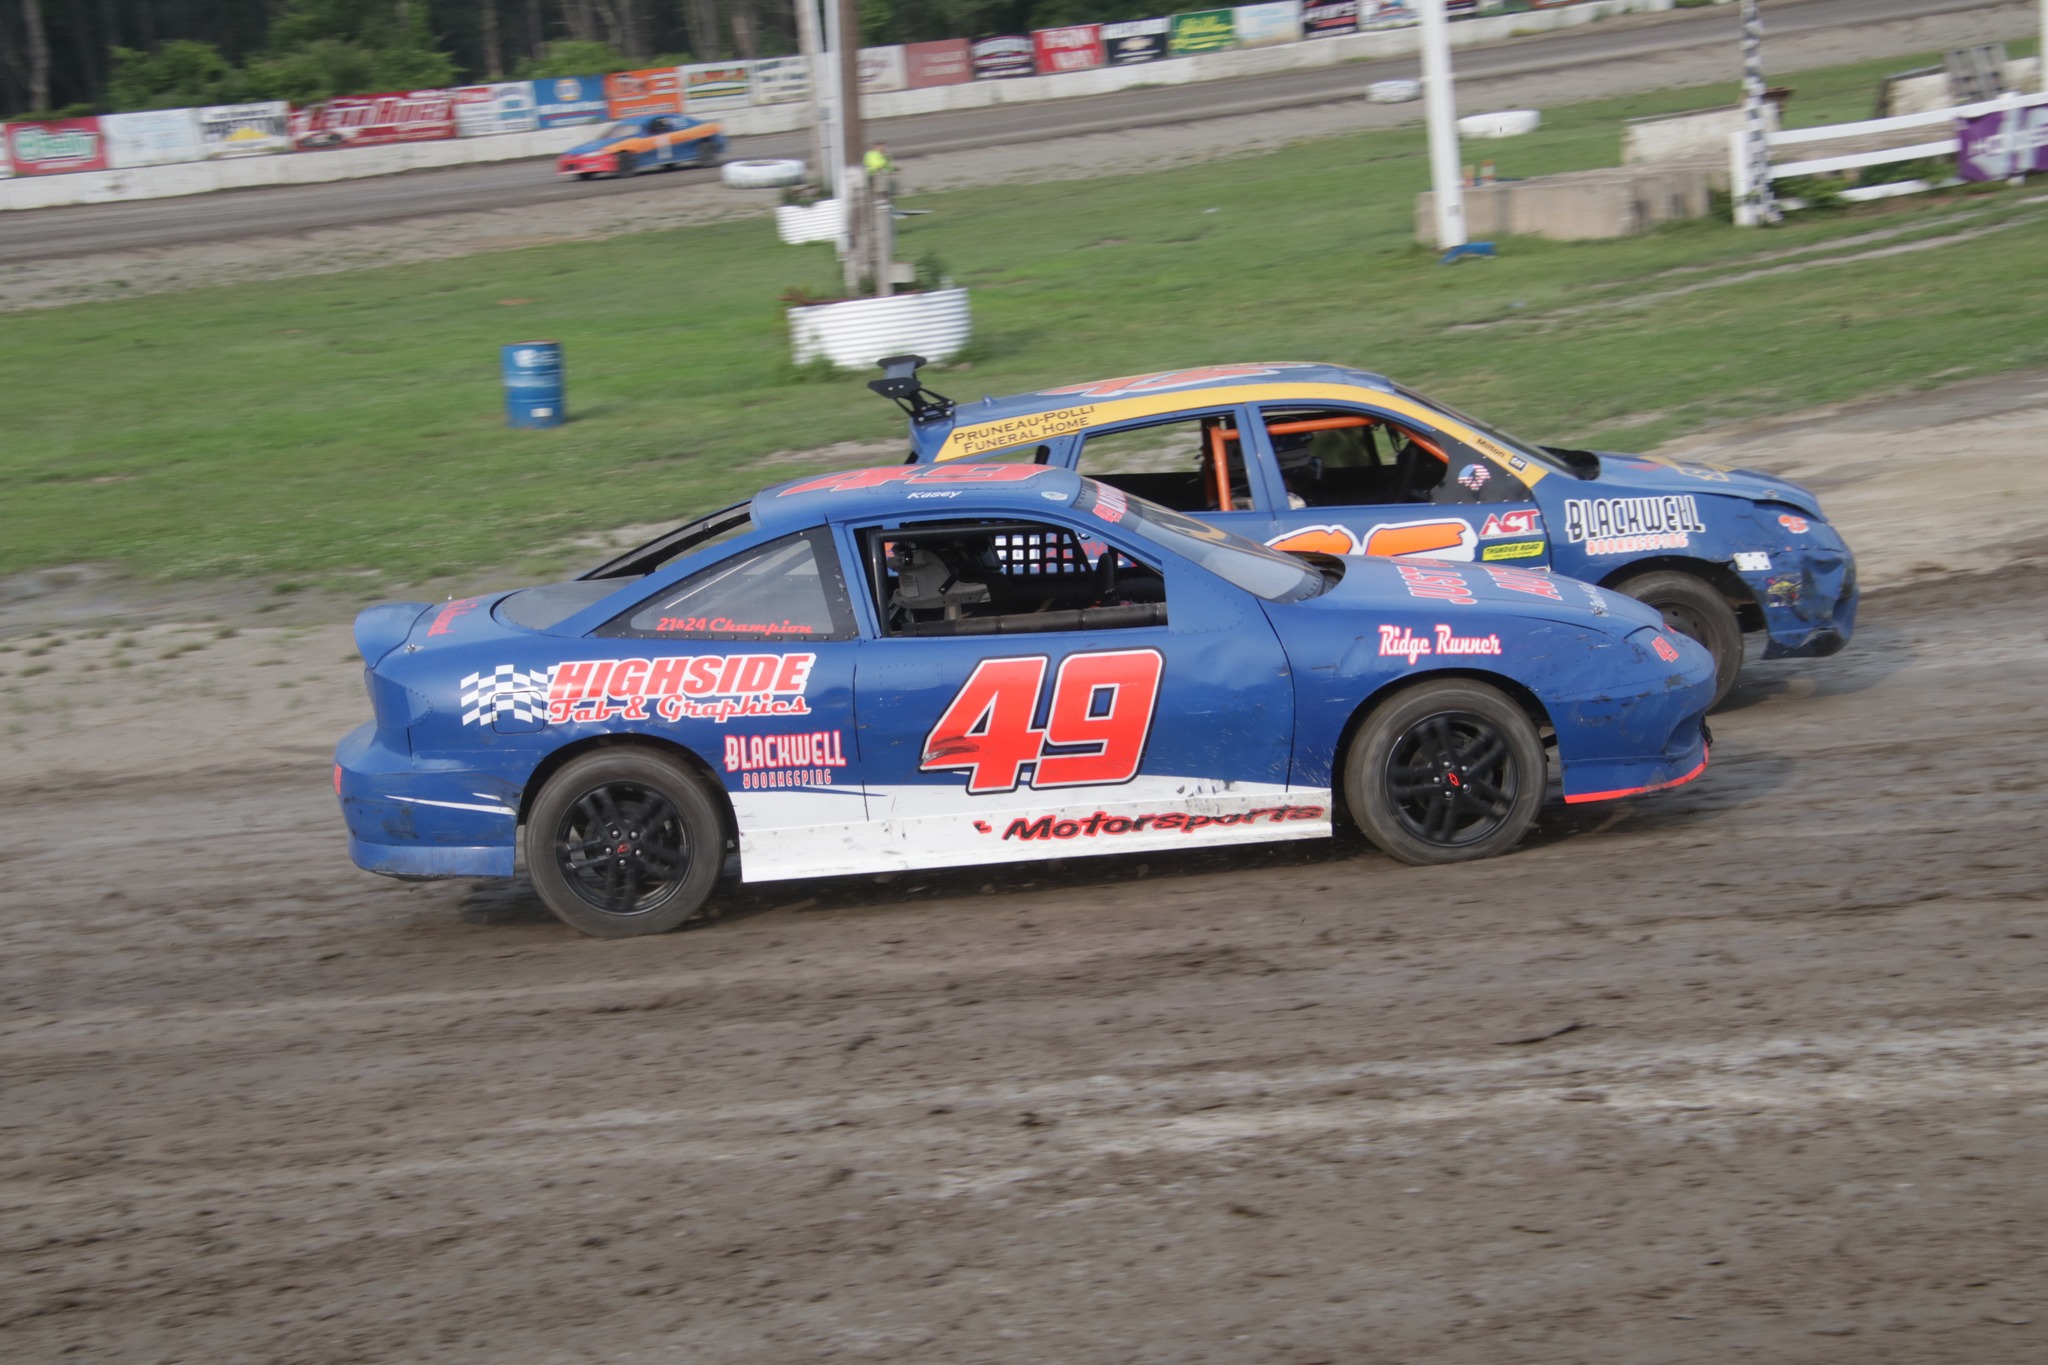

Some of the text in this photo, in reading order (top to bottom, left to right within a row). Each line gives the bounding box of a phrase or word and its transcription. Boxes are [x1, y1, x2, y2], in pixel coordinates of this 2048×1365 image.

[953, 405, 1095, 444] PRUNEAU-POLLI
[963, 416, 1090, 453] FUNERAL HOME
[907, 490, 962, 500] Kasey
[1479, 509, 1541, 538] ACT
[1565, 495, 1706, 543] BLACKWELL
[656, 617, 814, 636] 21&24 Champion
[1378, 624, 1502, 665] Ridge Runner
[548, 653, 816, 700] HIGHSIDE
[549, 693, 811, 724] Fab & Graphics
[918, 645, 1167, 797] 49
[724, 730, 847, 773] BLACKWELL
[743, 768, 832, 789] BOOKKEEPING
[1002, 805, 1325, 841] Motorsports
